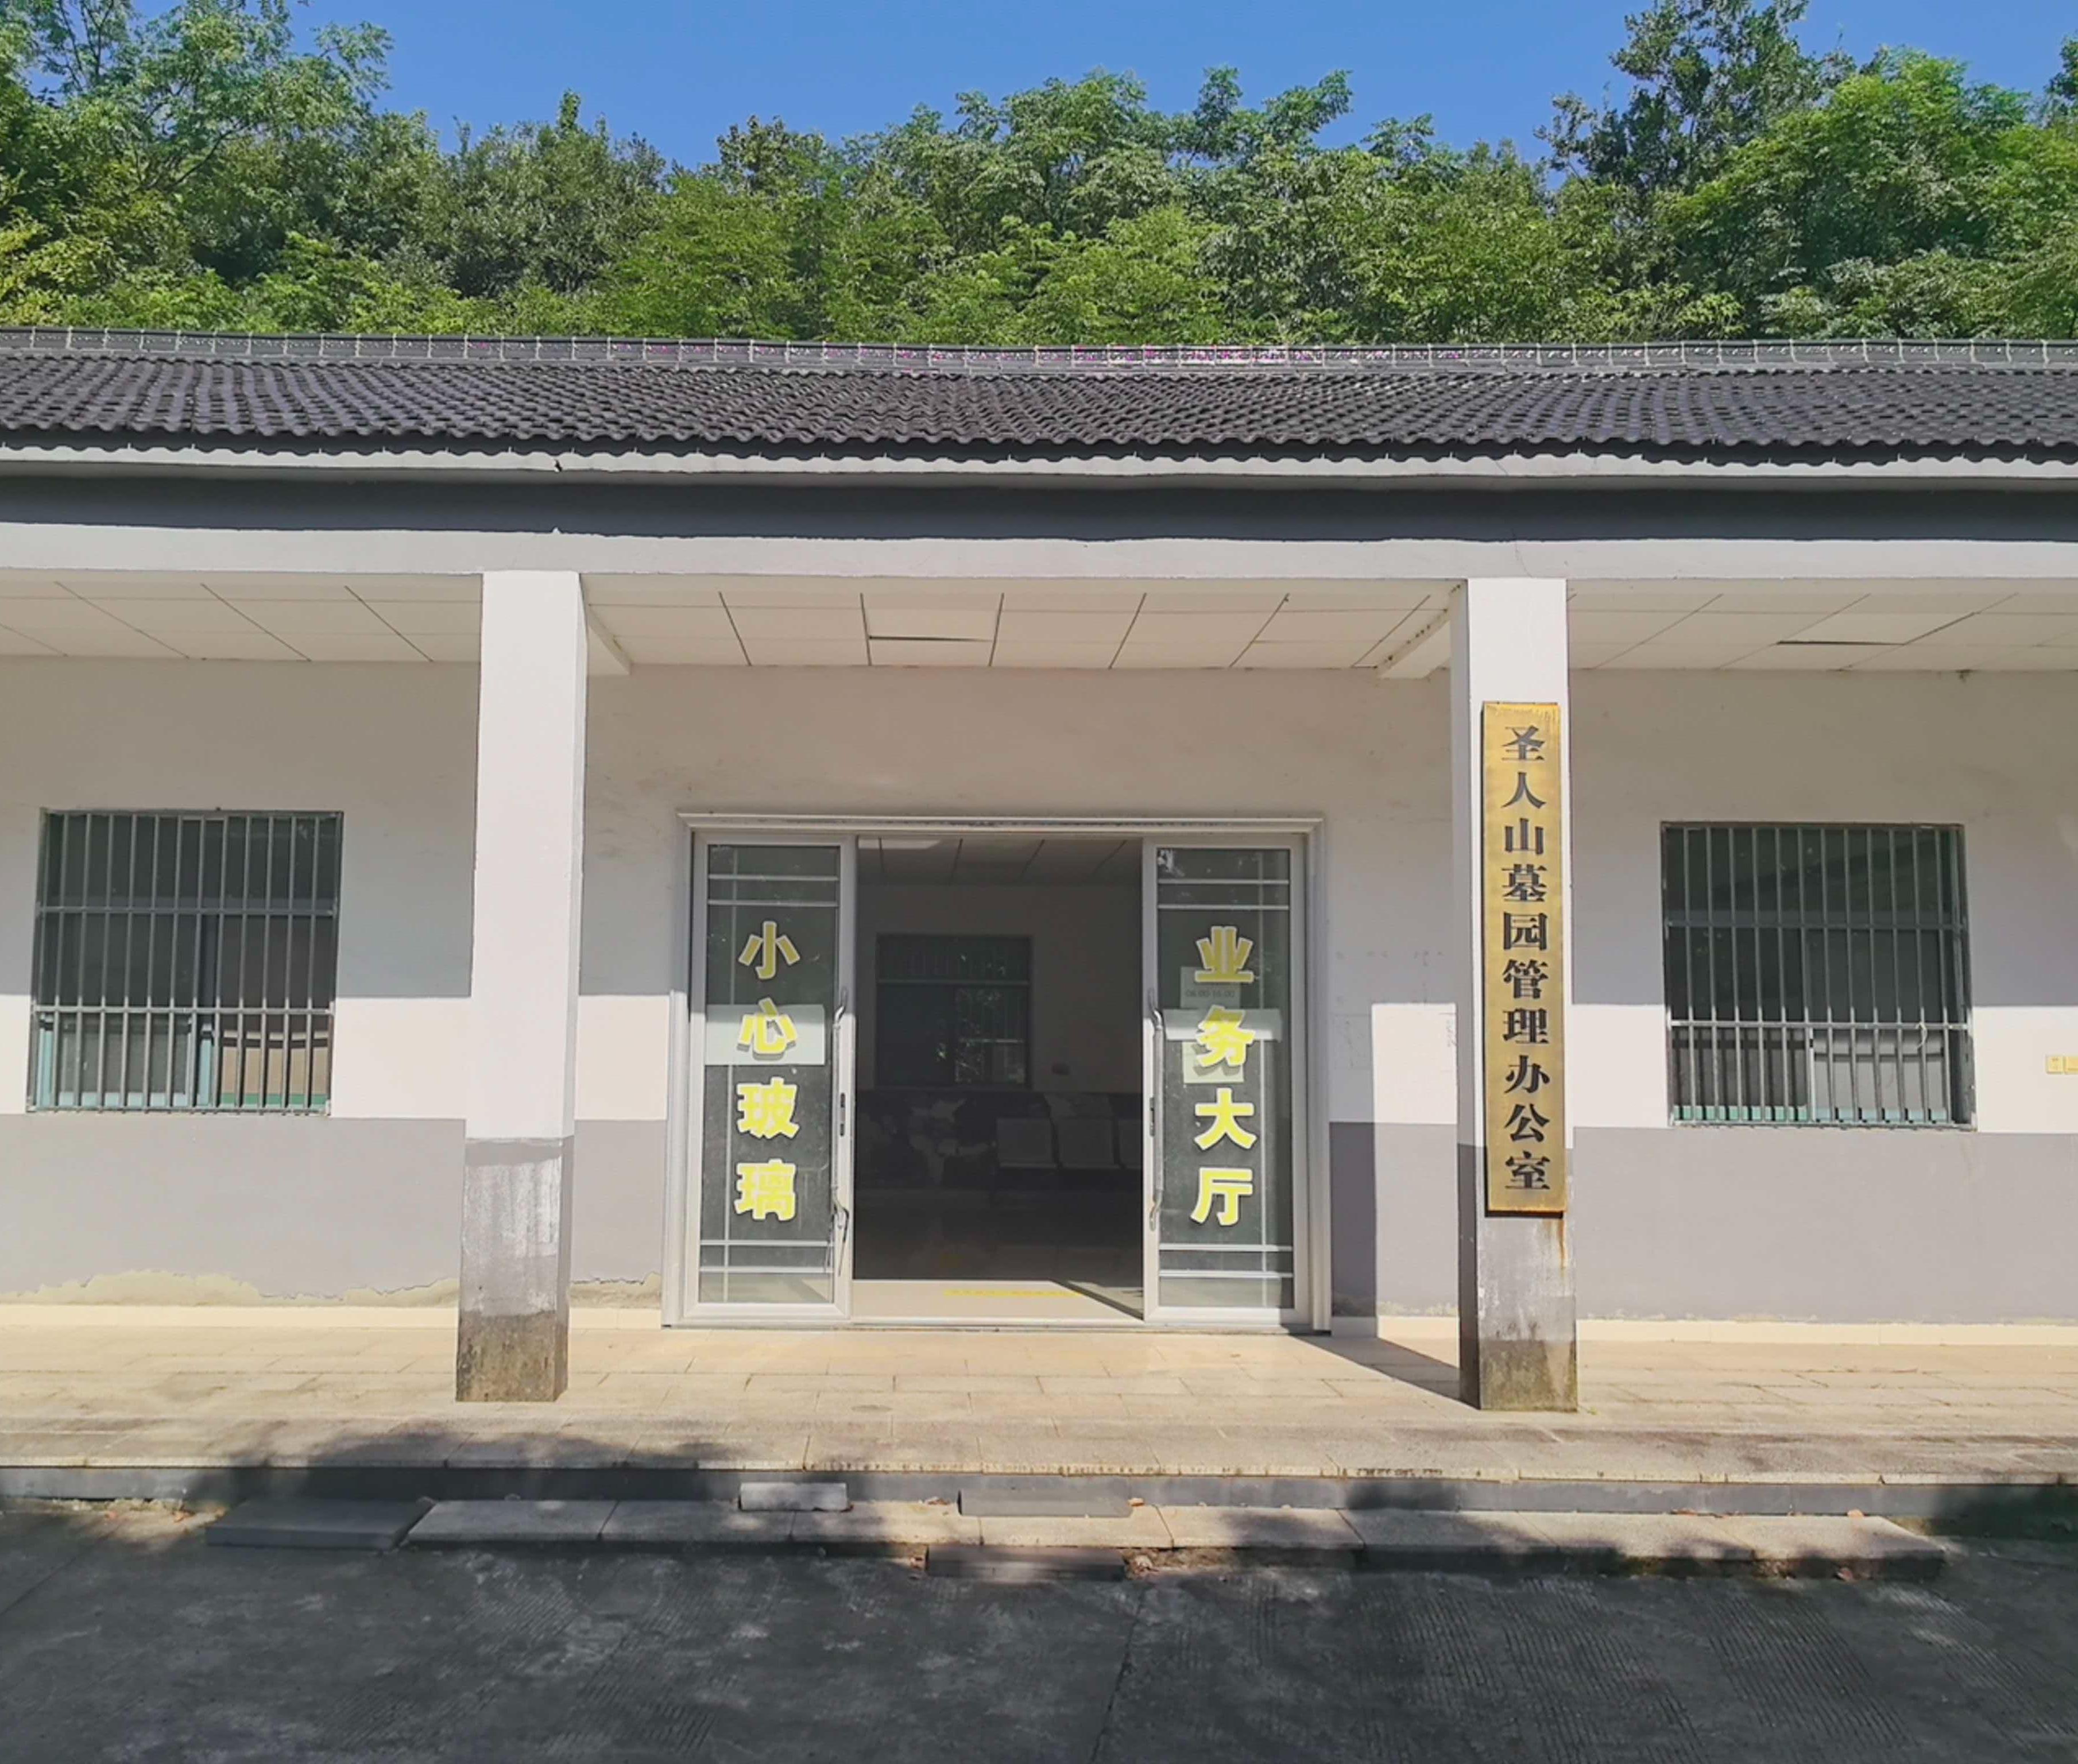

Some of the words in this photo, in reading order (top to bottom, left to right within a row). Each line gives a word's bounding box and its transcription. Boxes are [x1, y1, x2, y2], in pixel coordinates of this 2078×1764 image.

[734, 920, 801, 1221] 小心玻璃
[1190, 926, 1257, 1227] 业务大厅
[1502, 724, 1551, 1190] 圣人山墓园管理办公室
